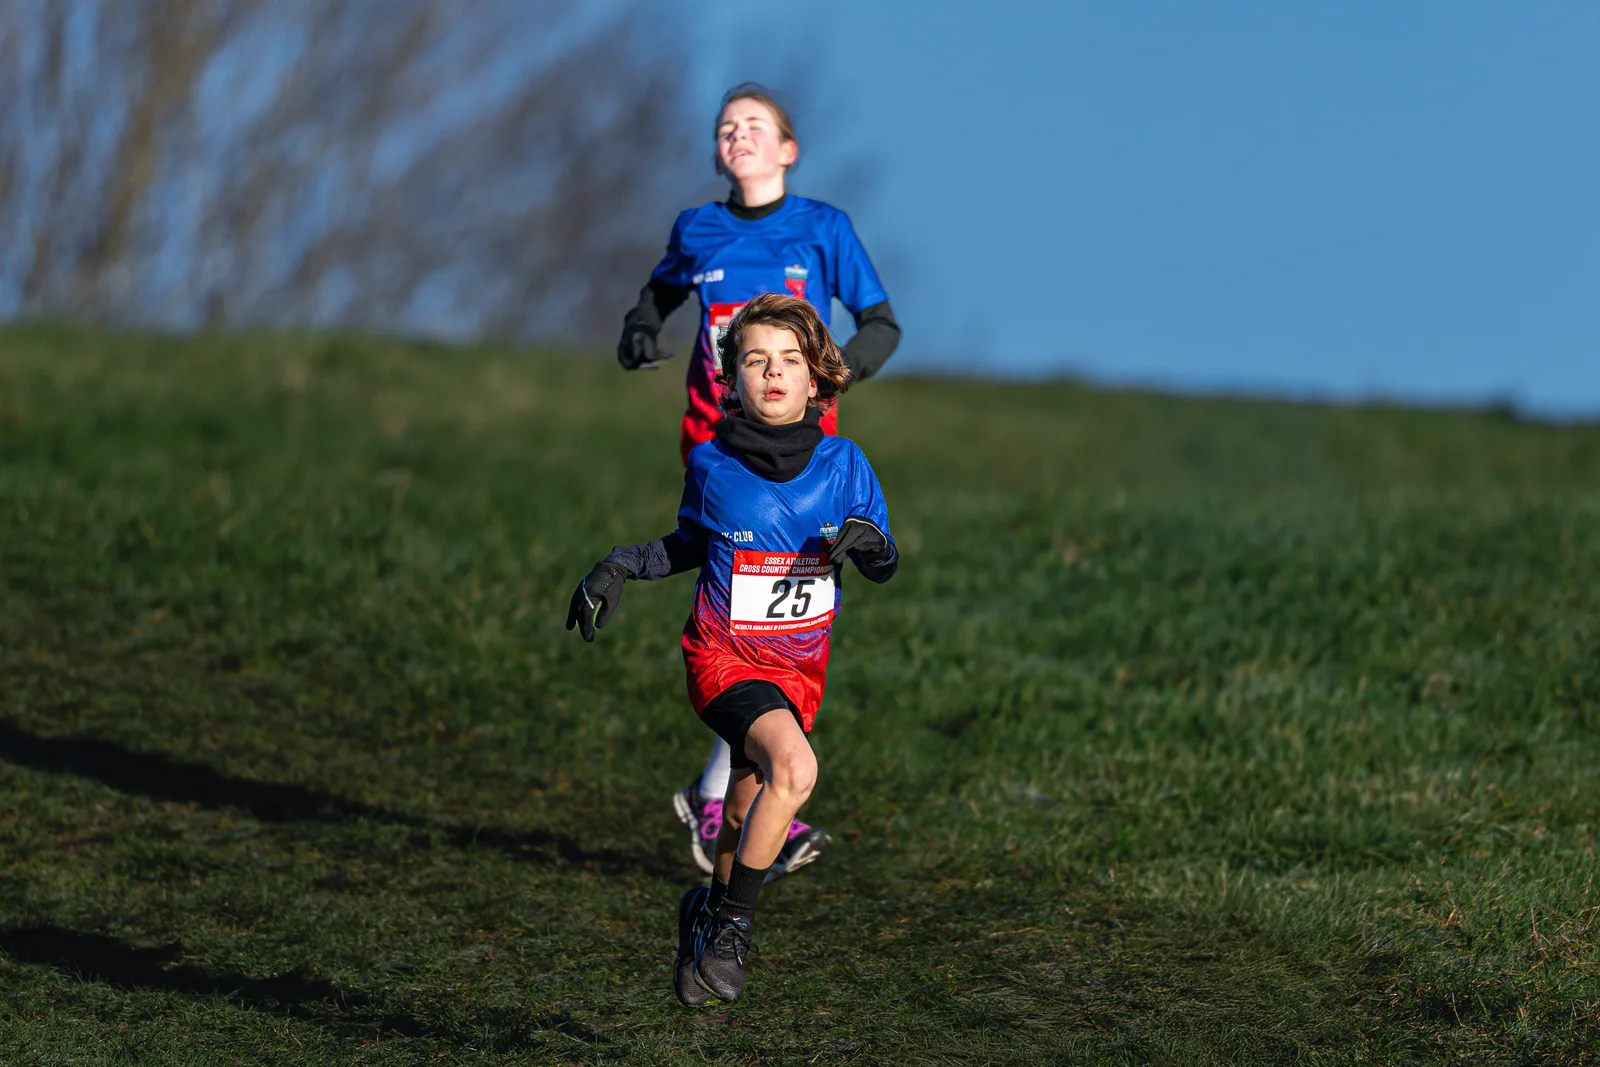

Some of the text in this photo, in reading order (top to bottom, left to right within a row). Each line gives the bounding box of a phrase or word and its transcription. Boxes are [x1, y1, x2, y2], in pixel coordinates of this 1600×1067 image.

[721, 531, 754, 542] Y-CLUB
[764, 557, 820, 565] ESSEX ATHLETICS
[739, 564, 761, 572] CROSS
[761, 565, 790, 574] COUNTRY
[766, 579, 815, 619] 25
